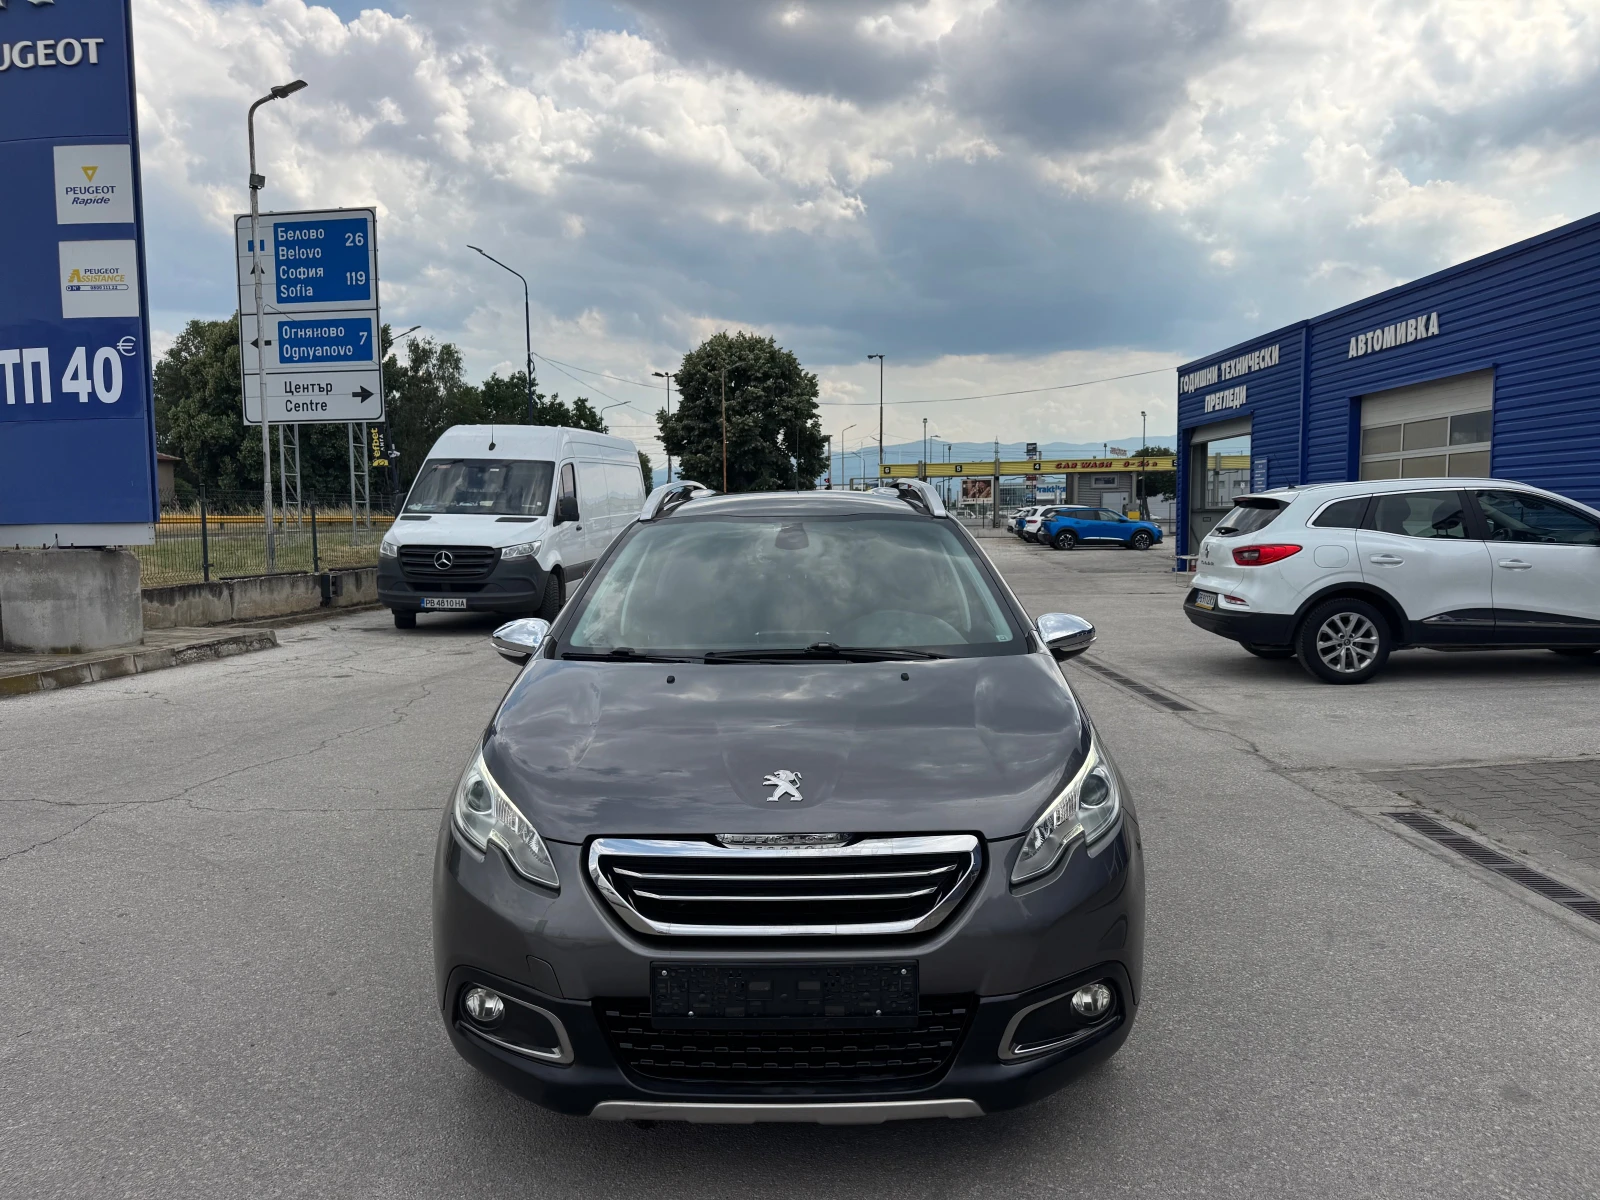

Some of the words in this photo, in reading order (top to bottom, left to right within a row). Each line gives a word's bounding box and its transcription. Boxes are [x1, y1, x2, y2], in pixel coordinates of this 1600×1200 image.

[65, 185, 116, 195] PEUGEOT
[71, 196, 111, 206] Rapide
[277, 227, 325, 241] Белово
[345, 233, 364, 246] 26
[279, 246, 322, 260] Belovo
[279, 265, 324, 279] София
[346, 271, 366, 285] 119
[280, 284, 314, 297] Sofia
[282, 325, 345, 339] Огняново
[359, 332, 368, 345] 7
[1348, 311, 1439, 359] АВТОМИВКА
[283, 344, 353, 360] Ognyanovo
[1180, 365, 1218, 393] ГОДИШНИ
[1221, 344, 1279, 381] ТЕХНИЧЕСКИ
[284, 381, 333, 396] Център
[285, 399, 328, 412] Centre
[1204, 384, 1247, 413] ПРЕГЛЕДИ
[371, 427, 381, 457] efbet
[1081, 461, 1113, 469] WASH
